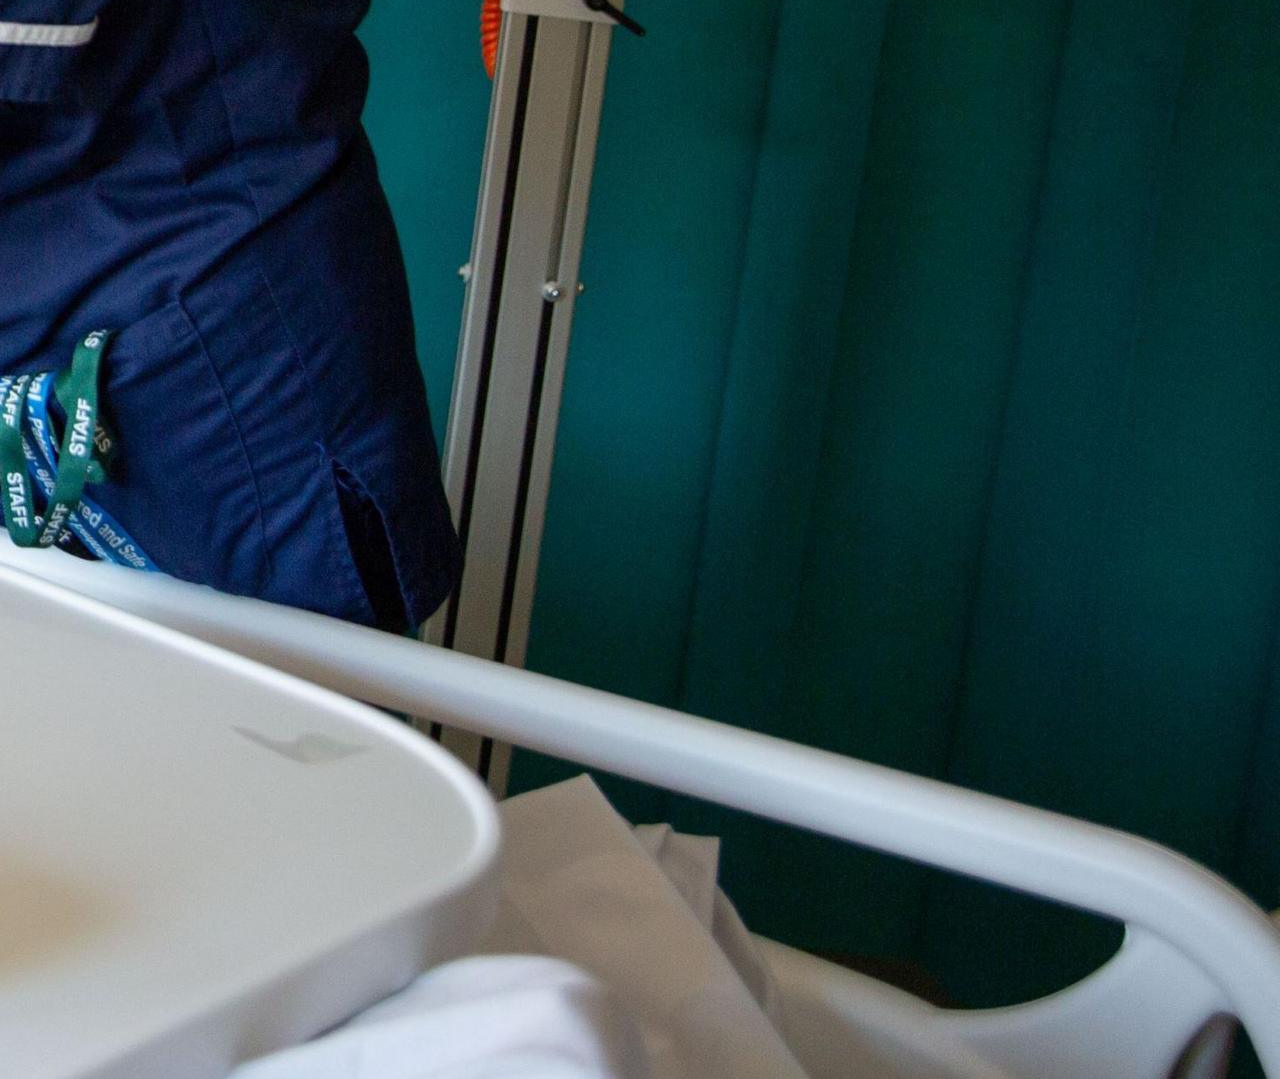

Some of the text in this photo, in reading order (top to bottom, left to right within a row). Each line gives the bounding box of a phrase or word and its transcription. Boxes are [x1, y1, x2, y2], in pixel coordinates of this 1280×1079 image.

[69, 398, 92, 457] STAFF
[7, 472, 29, 528] STAFF
[40, 503, 69, 545] STAFF
[98, 523, 126, 549] and
